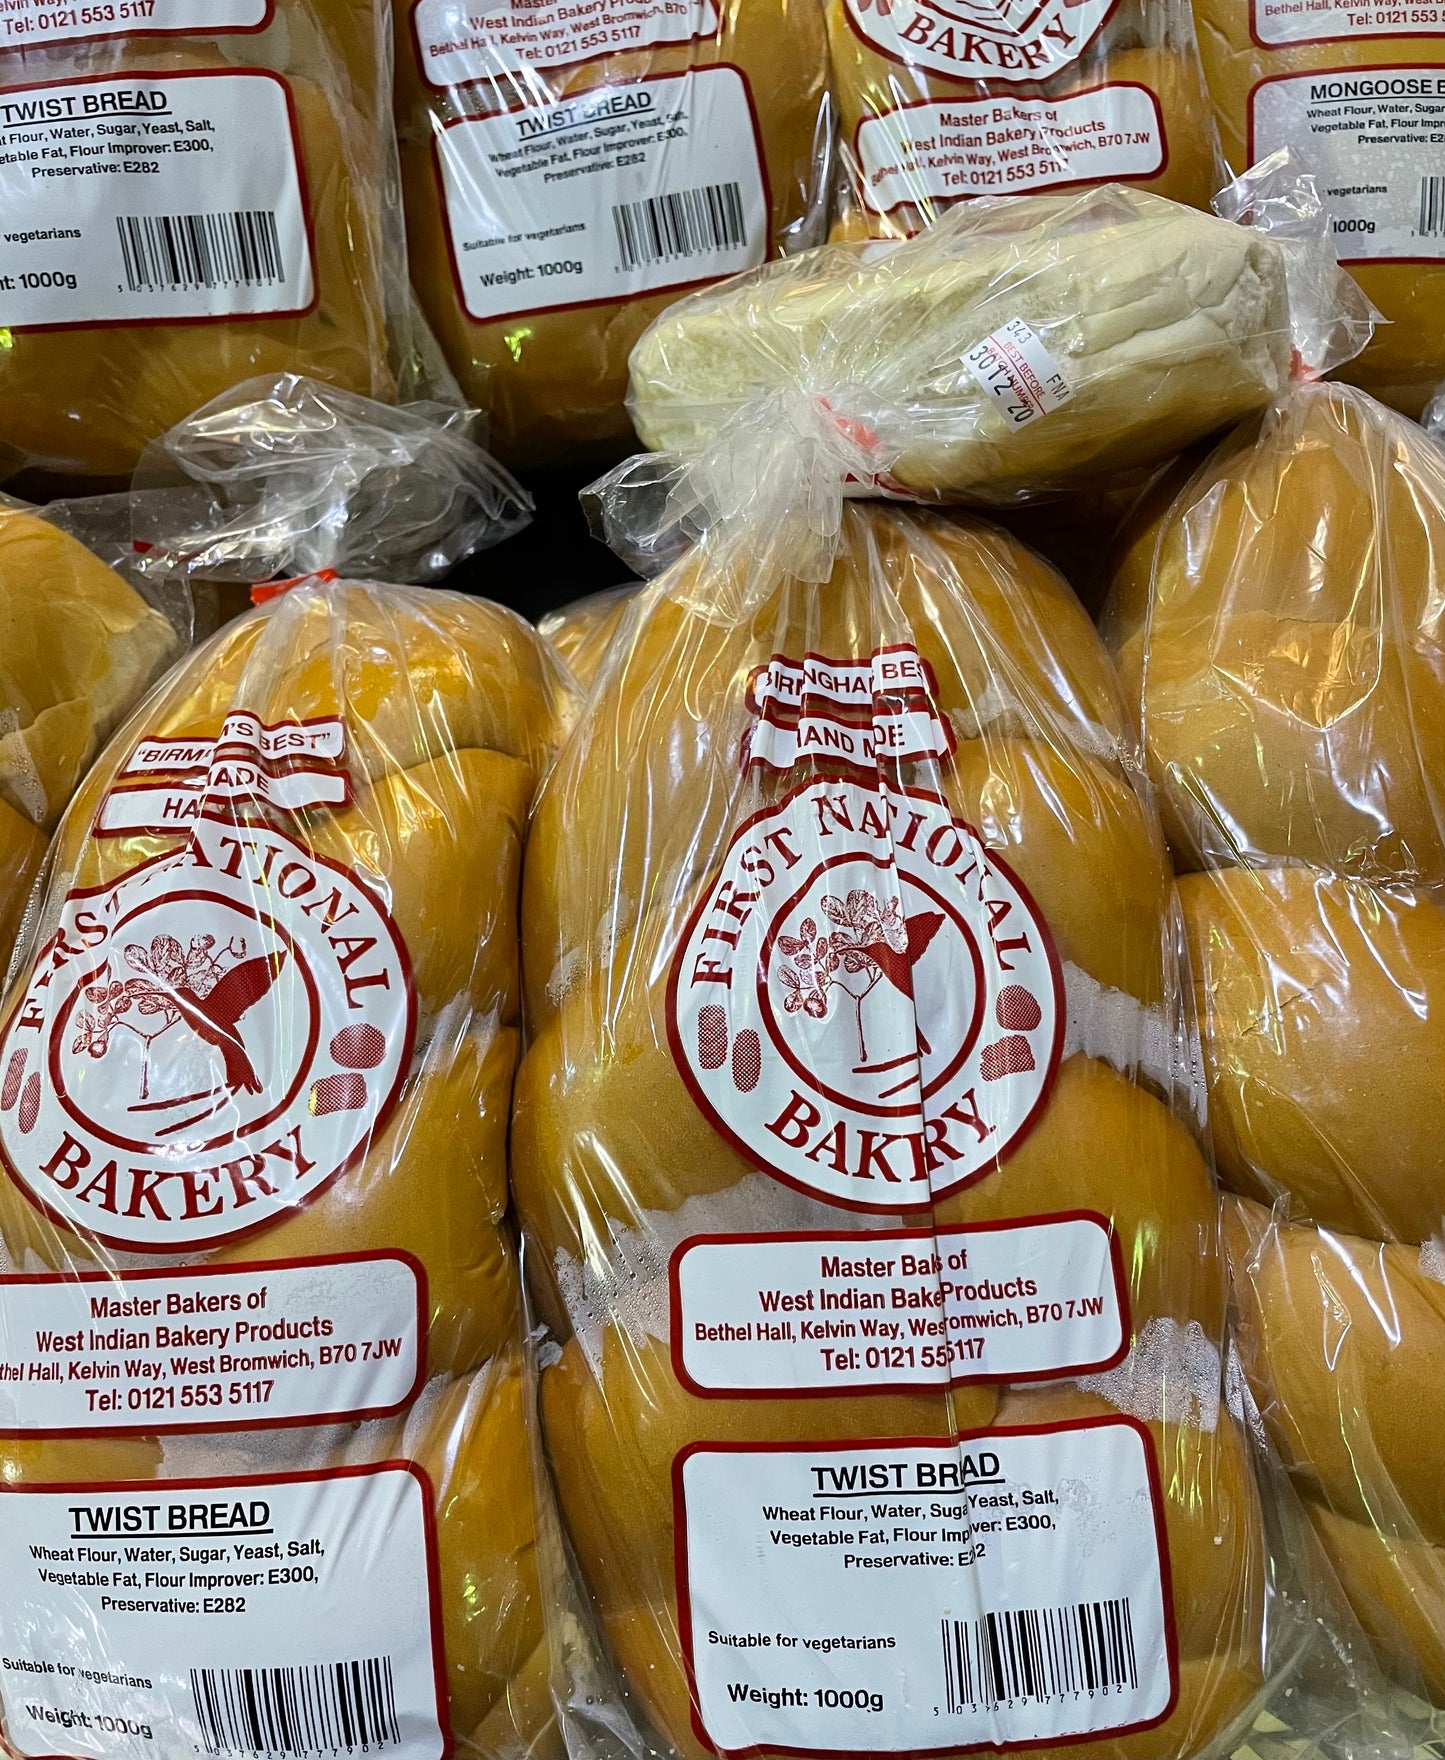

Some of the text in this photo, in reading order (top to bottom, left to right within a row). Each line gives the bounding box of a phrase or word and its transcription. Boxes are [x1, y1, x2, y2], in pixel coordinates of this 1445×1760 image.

[2, 0, 155, 35] Tel: 0121 553 5117
[470, 14, 555, 30] West Indian
[570, 17, 601, 33] West
[665, 2, 688, 15] B70
[1265, 1, 1331, 16] Bethel Hall,
[1347, 12, 1373, 26] Tel:
[1376, 10, 1407, 24] 0121
[1411, 9, 1438, 23] 553
[516, 25, 641, 60] Tel: 0121 553 5117
[897, 12, 1077, 70] BAKERY
[1310, 79, 1432, 100] MONGOOSE
[0, 91, 168, 123] TWIST BREAD
[940, 106, 1058, 127] Master Bakers of
[1307, 103, 1412, 118] Wheat Flour, Water,
[10, 130, 49, 147] Flour,
[49, 126, 95, 141] Water,
[97, 123, 141, 138] Sugar,
[142, 121, 184, 135] Yeast,
[186, 119, 216, 132] Salt,
[516, 107, 576, 136] TWIST
[594, 124, 631, 138] Sugar,
[1311, 118, 1417, 133] Vegetable Fat, Flour
[42, 138, 214, 161] Fat, Flour Improver: E300,
[928, 132, 1150, 168] Kelvin Way, West B70 7JW
[940, 134, 982, 147] Indian
[986, 127, 1036, 146] Bakery
[1358, 134, 1428, 144] Preservative:
[573, 145, 601, 160] Flour
[32, 161, 160, 178] Preservative: E282
[544, 152, 646, 183] Preservative: E282
[942, 162, 1035, 187] Tel: 0121 553
[1327, 185, 1387, 198] vegetarians
[4, 228, 81, 244] vegetarians
[1333, 219, 1376, 234] 1000g
[18, 271, 77, 290] 1000g
[480, 260, 583, 287] Weight: 1000g
[1007, 320, 1032, 344] 343
[970, 345, 996, 370] 30
[1007, 403, 1035, 423] 20
[1003, 342, 1046, 400] BEST BEFORE
[1046, 373, 1070, 401] FNA
[691, 826, 803, 990] FIRST
[40, 1124, 317, 1221] BAKERY
[821, 1249, 968, 1279] Master of
[90, 1287, 268, 1319] Master Bakers of
[759, 1275, 1037, 1312] West Indian Products
[695, 1296, 1104, 1344] Bethel Hall, Kelvin Way, B70 7JW
[36, 1317, 333, 1353] West Indian Bakery Products
[28, 1338, 402, 1384] Hall, Kelvin Way, West Bromwich, B70 7JW
[820, 1346, 916, 1371] Tel: 0121
[85, 1380, 275, 1411] Tel: 0121 553 5117
[811, 1464, 908, 1492] TWIST
[68, 1501, 271, 1532] TWIST BREAD
[763, 1488, 1059, 1523] Wheat Flour, Water, Yeast, Salt,
[769, 1513, 1057, 1549] Vegetable Fat, Flour E300,
[29, 1538, 325, 1566] Wheat Flour, Water, Sugar, Yeast, Salt,
[844, 1552, 954, 1569] Preservative:
[37, 1565, 319, 1591] Vegetable Fat, Flour Improver: E300,
[102, 1595, 246, 1614] Preservative: E282
[708, 1630, 897, 1653] Suitable for vegetarians
[2, 1657, 153, 1690] Suitable for vegetarians
[727, 1683, 884, 1712] Weight: 1000g
[26, 1704, 153, 1740] Weight: 1000g
